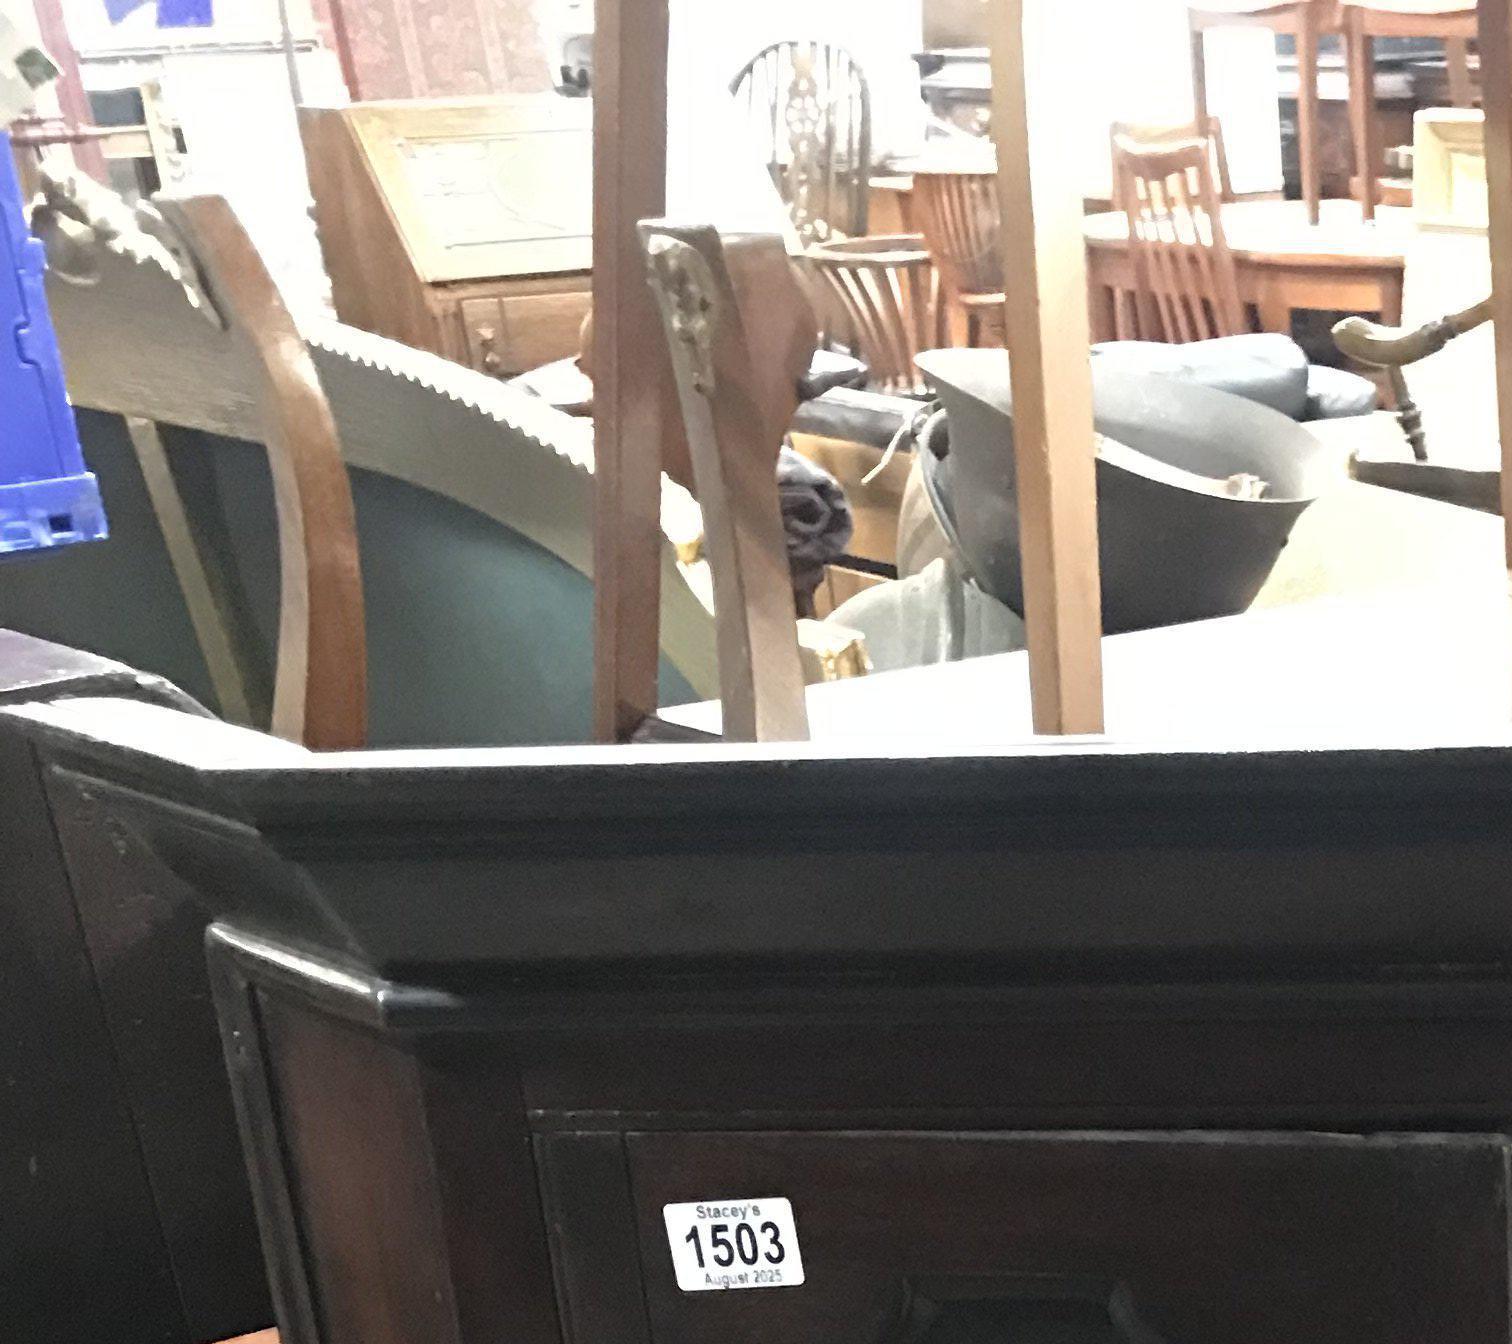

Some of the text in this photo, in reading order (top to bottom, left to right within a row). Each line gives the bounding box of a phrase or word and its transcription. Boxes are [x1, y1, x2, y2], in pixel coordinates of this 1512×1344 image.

[695, 1203, 761, 1220] Stacey's
[685, 1221, 785, 1268] 1503
[705, 1269, 783, 1289] August 2025
